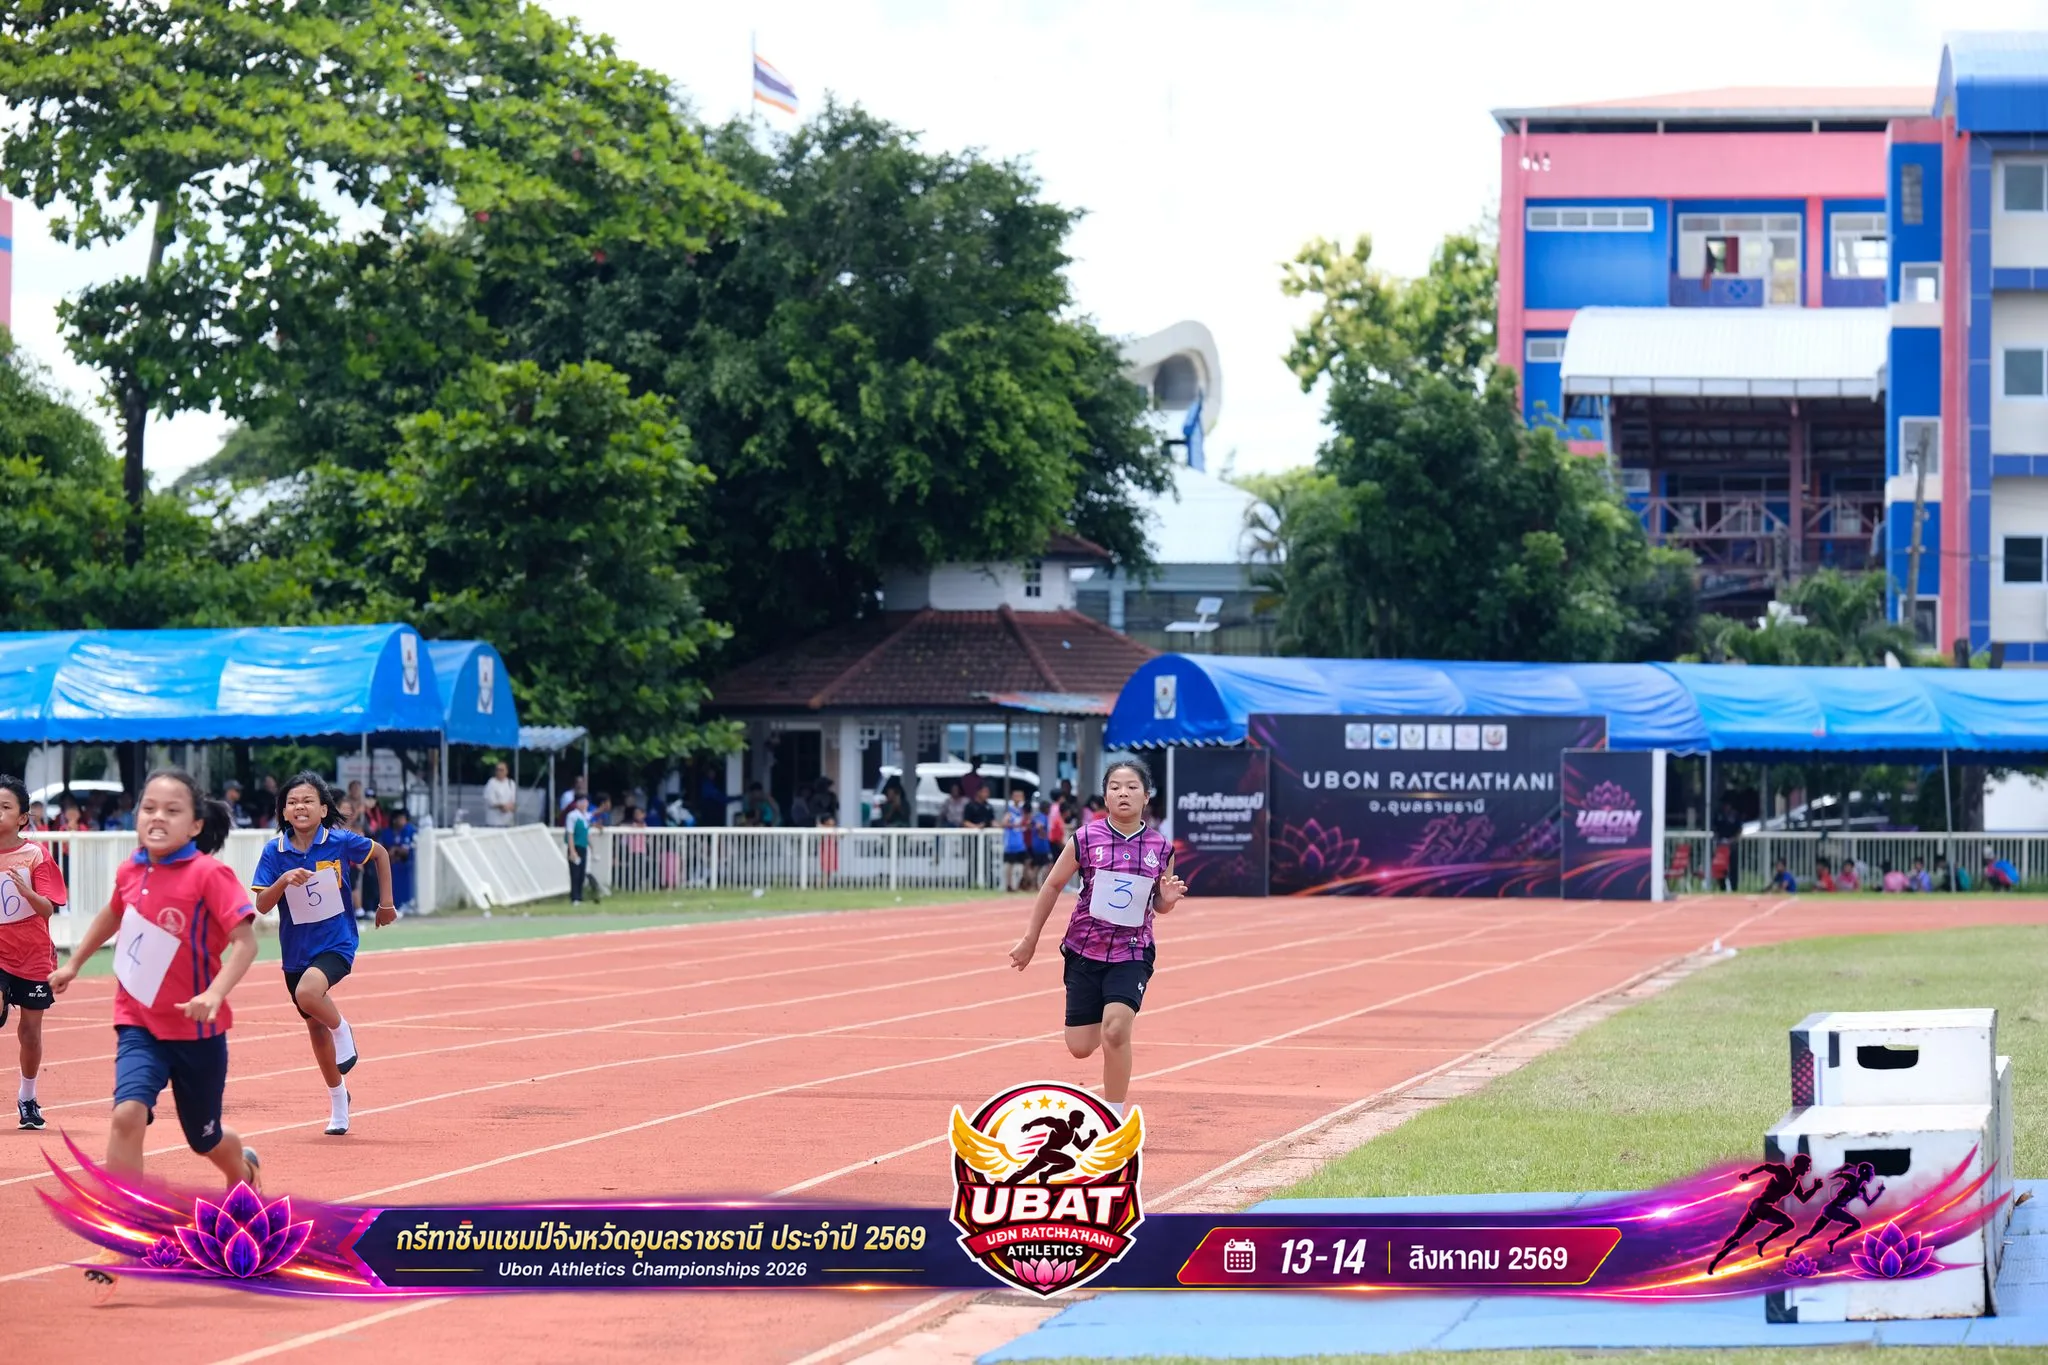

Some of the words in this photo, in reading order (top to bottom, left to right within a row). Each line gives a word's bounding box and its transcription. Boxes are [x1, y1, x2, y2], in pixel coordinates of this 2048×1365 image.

[1303, 771, 1379, 789] UBON
[1390, 771, 1554, 790] RATCHATHANI
[1576, 810, 1642, 828] UBON
[1, 879, 20, 916] 6
[306, 882, 322, 907] 5
[1108, 879, 1132, 909] 3
[127, 933, 144, 968] 4
